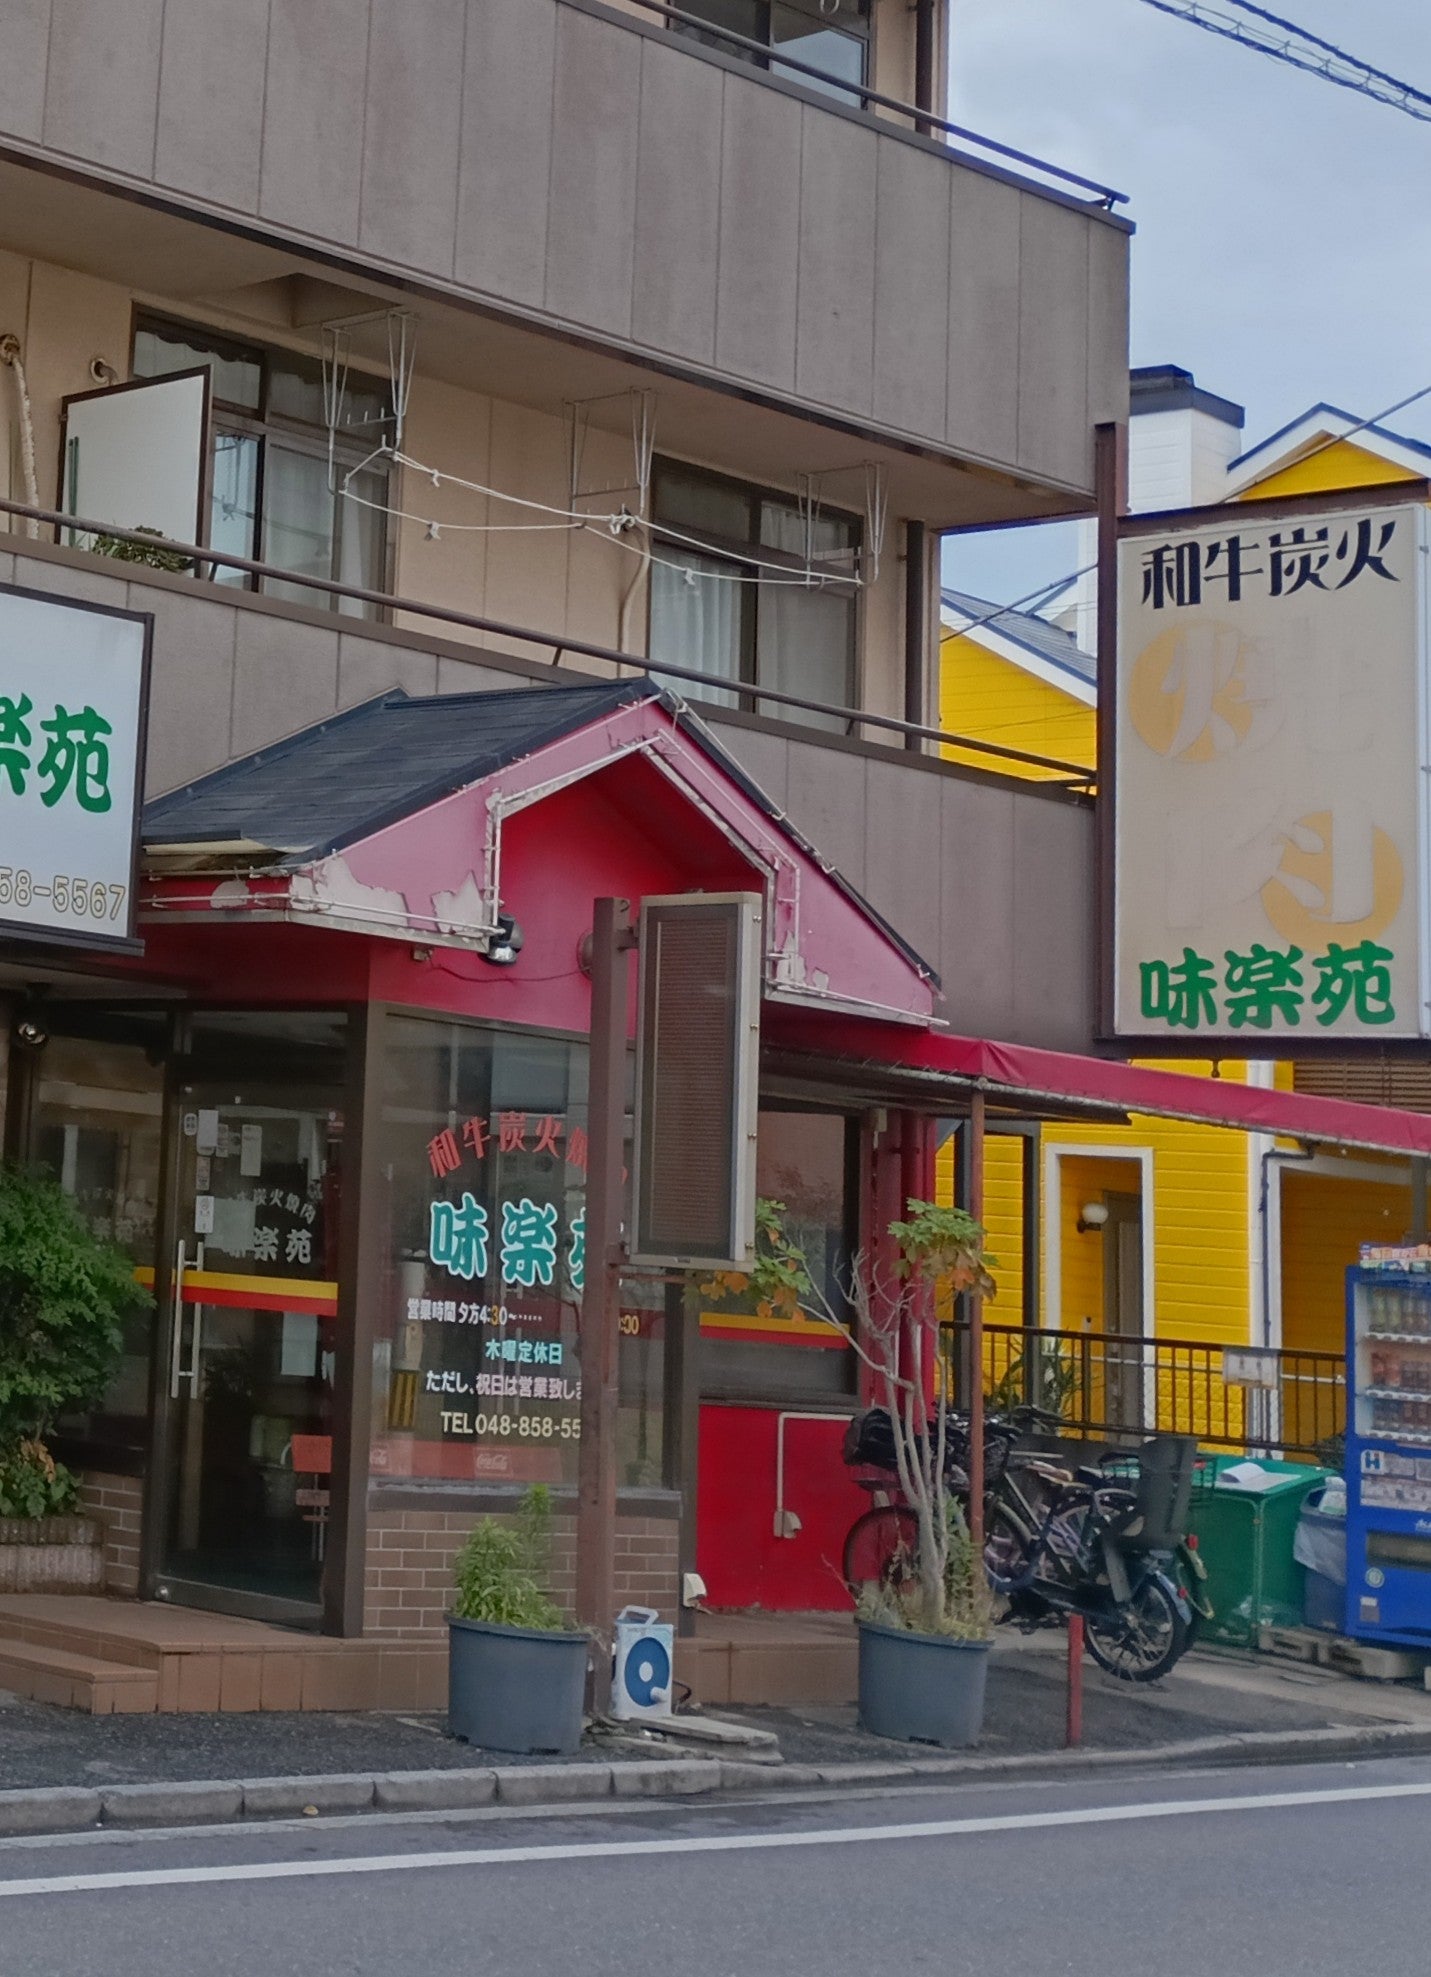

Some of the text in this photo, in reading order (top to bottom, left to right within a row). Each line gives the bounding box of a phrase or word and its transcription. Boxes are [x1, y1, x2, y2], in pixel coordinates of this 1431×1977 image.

[1141, 518, 1400, 609] 和牛炭火
[1139, 940, 1396, 1029] 味楽苑
[224, 1226, 312, 1264] 楽苑
[430, 1192, 587, 1289] 味楽
[485, 1339, 563, 1365] 木曜定休日
[441, 1411, 473, 1434] TEL
